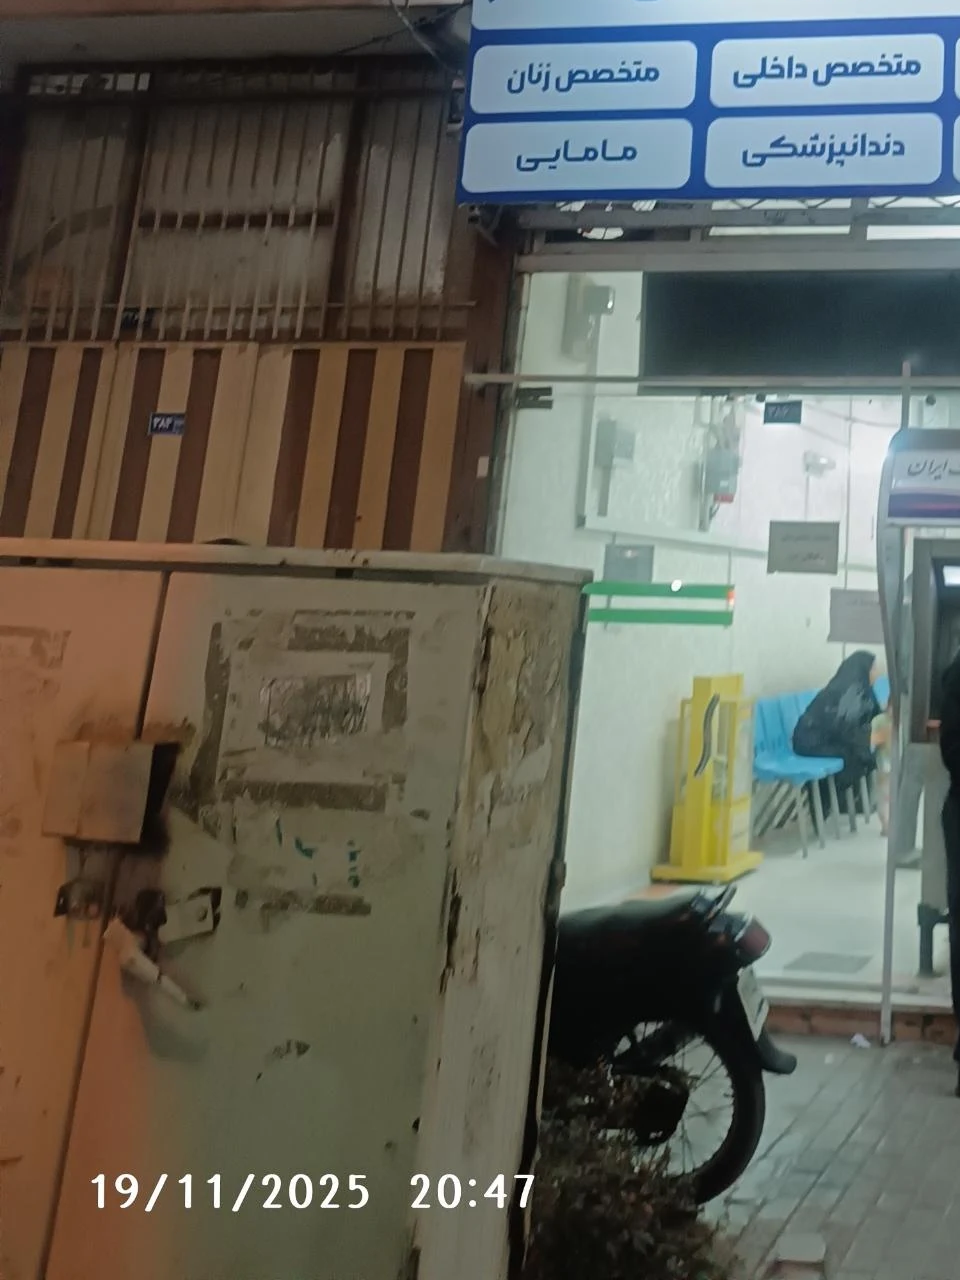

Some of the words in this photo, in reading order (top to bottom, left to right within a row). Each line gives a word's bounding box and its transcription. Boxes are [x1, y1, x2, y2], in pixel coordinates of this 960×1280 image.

[507, 62, 551, 94] زنان
[555, 60, 660, 93] متخصص
[733, 55, 807, 88] داخلی
[813, 53, 922, 87] متخصص
[516, 138, 638, 171] مامایی
[742, 133, 906, 168] دندانپزشکی
[907, 458, 949, 480] ایران
